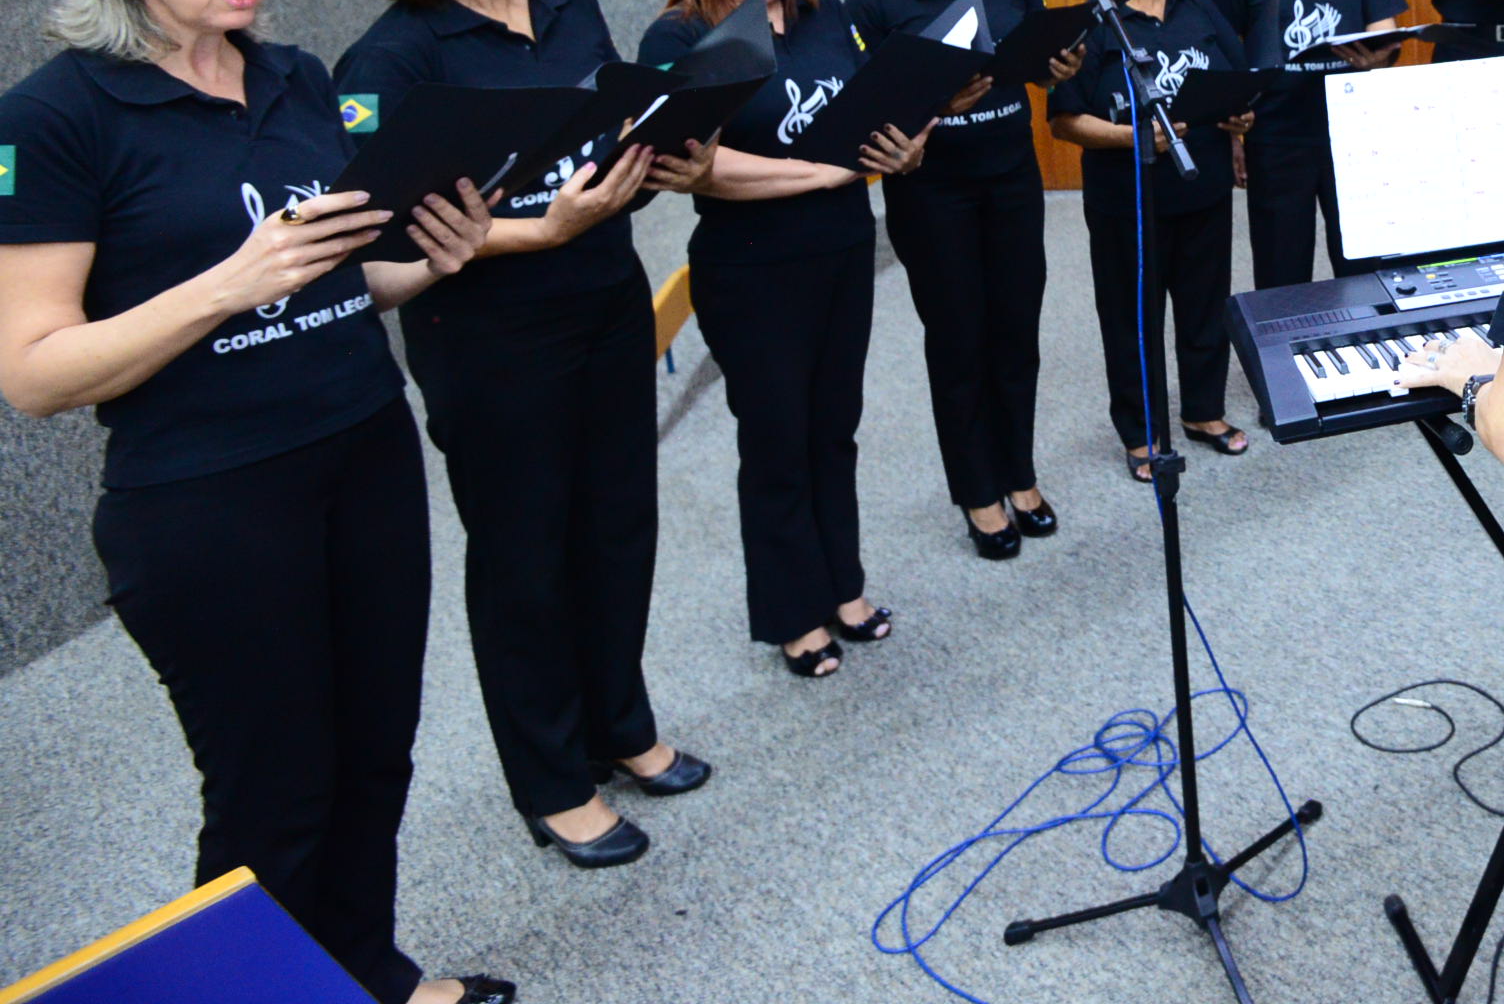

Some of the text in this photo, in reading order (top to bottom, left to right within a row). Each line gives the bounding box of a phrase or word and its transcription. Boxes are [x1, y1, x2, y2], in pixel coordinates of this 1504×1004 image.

[1304, 62, 1325, 71] TOM
[1326, 60, 1351, 70] LEGA
[969, 110, 996, 124] TOM
[510, 188, 560, 209] CORA
[212, 322, 294, 354] CORAL
[334, 292, 374, 319] LEGA
